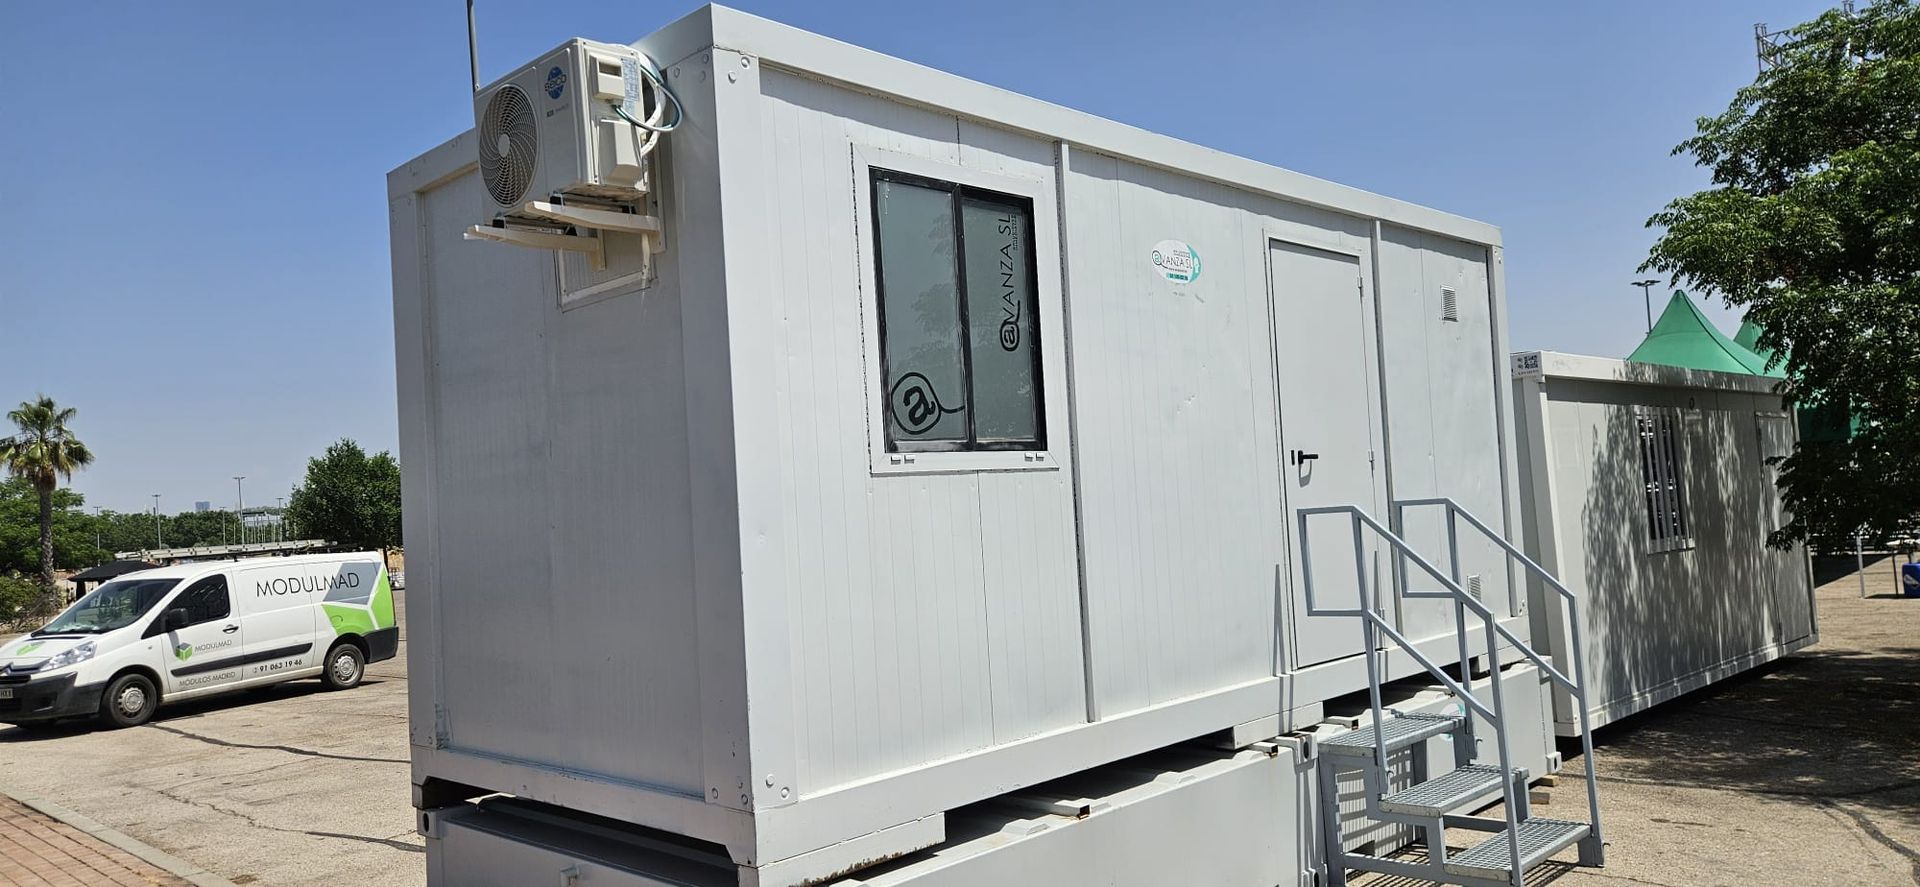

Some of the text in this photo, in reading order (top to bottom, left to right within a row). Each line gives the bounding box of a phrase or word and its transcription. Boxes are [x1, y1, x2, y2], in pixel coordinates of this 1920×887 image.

[998, 214, 1012, 236] SL
[256, 572, 360, 597] MODULMAD
[194, 640, 232, 652] MODULMAD
[270, 662, 283, 671] 063
[285, 661, 293, 669] 19
[212, 671, 236, 682] MADRID
